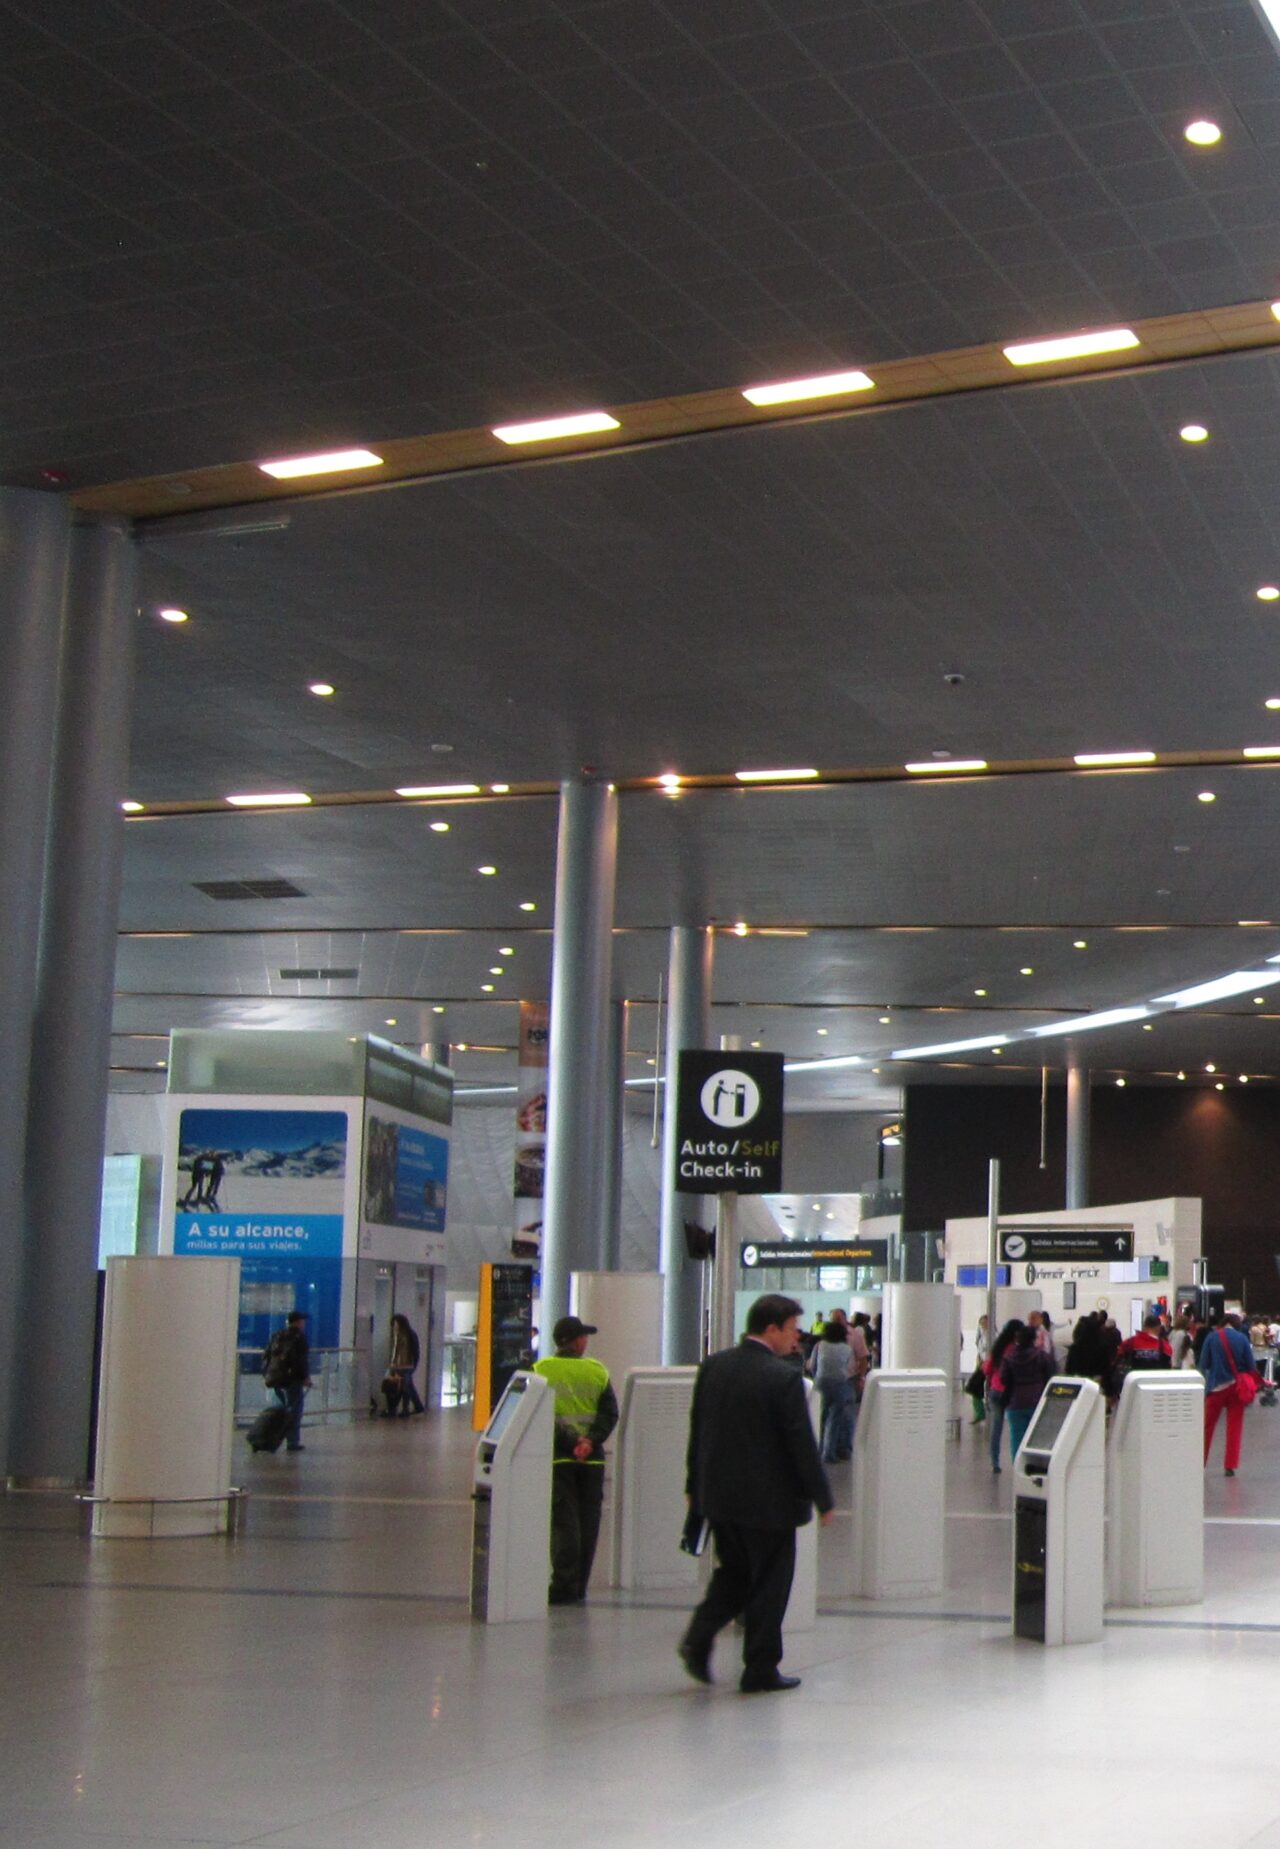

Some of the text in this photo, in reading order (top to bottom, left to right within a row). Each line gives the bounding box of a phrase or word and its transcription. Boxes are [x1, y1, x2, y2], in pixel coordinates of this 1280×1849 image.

[680, 1161, 762, 1178] Check-in
[188, 1222, 309, 1240] A su alcance,
[186, 1240, 218, 1249] millas
[220, 1241, 249, 1250] para
[250, 1242, 265, 1250] sus
